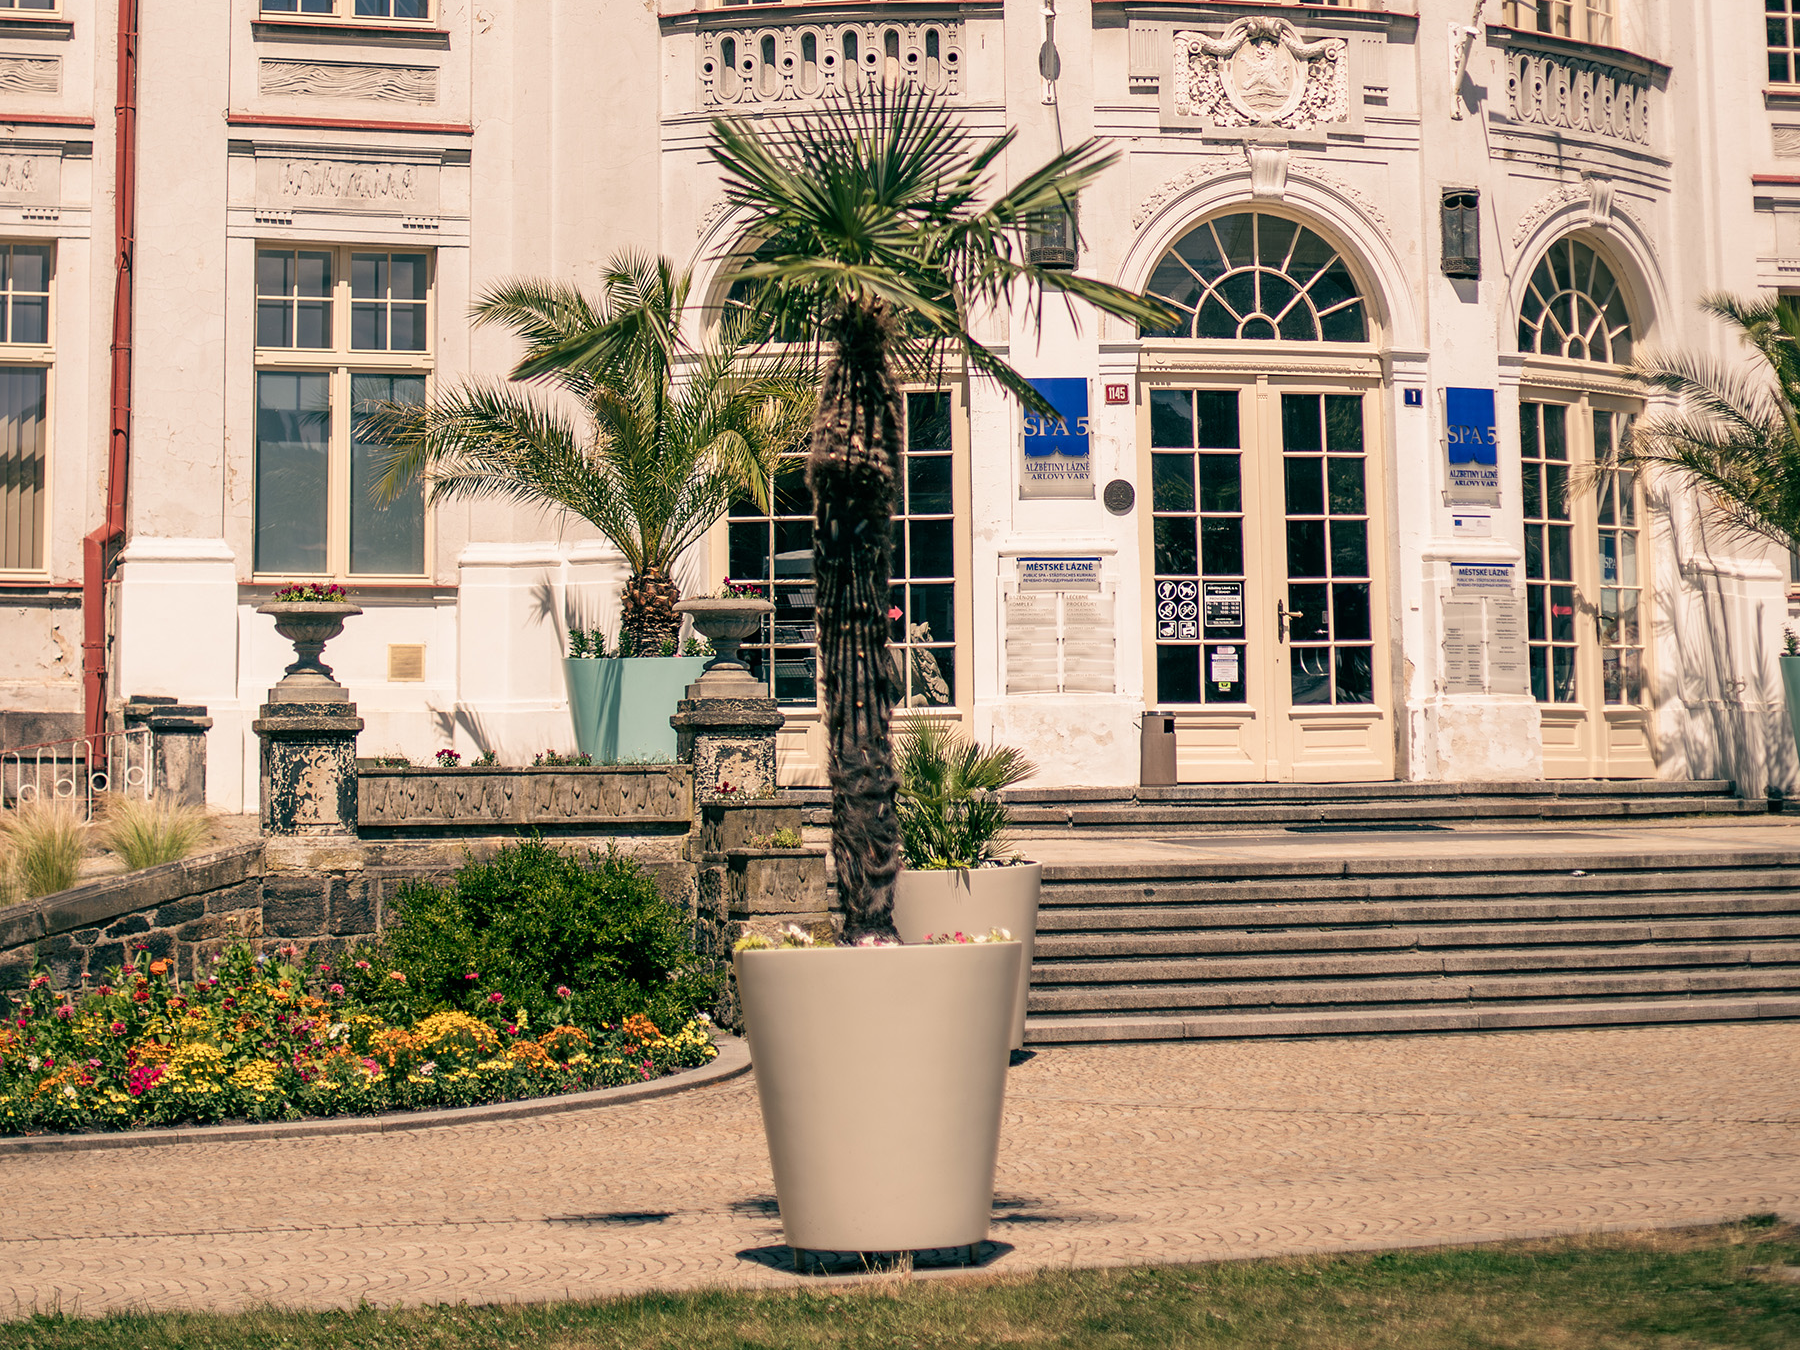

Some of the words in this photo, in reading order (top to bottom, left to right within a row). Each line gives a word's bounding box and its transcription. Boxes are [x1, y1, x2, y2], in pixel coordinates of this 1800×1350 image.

[1108, 386, 1127, 400] 1145
[1411, 391, 1416, 402] 1
[1023, 416, 1071, 438] SPA
[1075, 416, 1090, 437] 5
[1447, 424, 1484, 445] SPA
[1487, 426, 1498, 446] 5
[1066, 460, 1090, 471] LÁZNĚ
[1026, 562, 1065, 571] MĚSTSKÉ
[1065, 562, 1094, 571] LÁZNĚ
[1458, 567, 1488, 576] MĚSTSKÉ
[1488, 567, 1510, 577] LÁZNĚ
